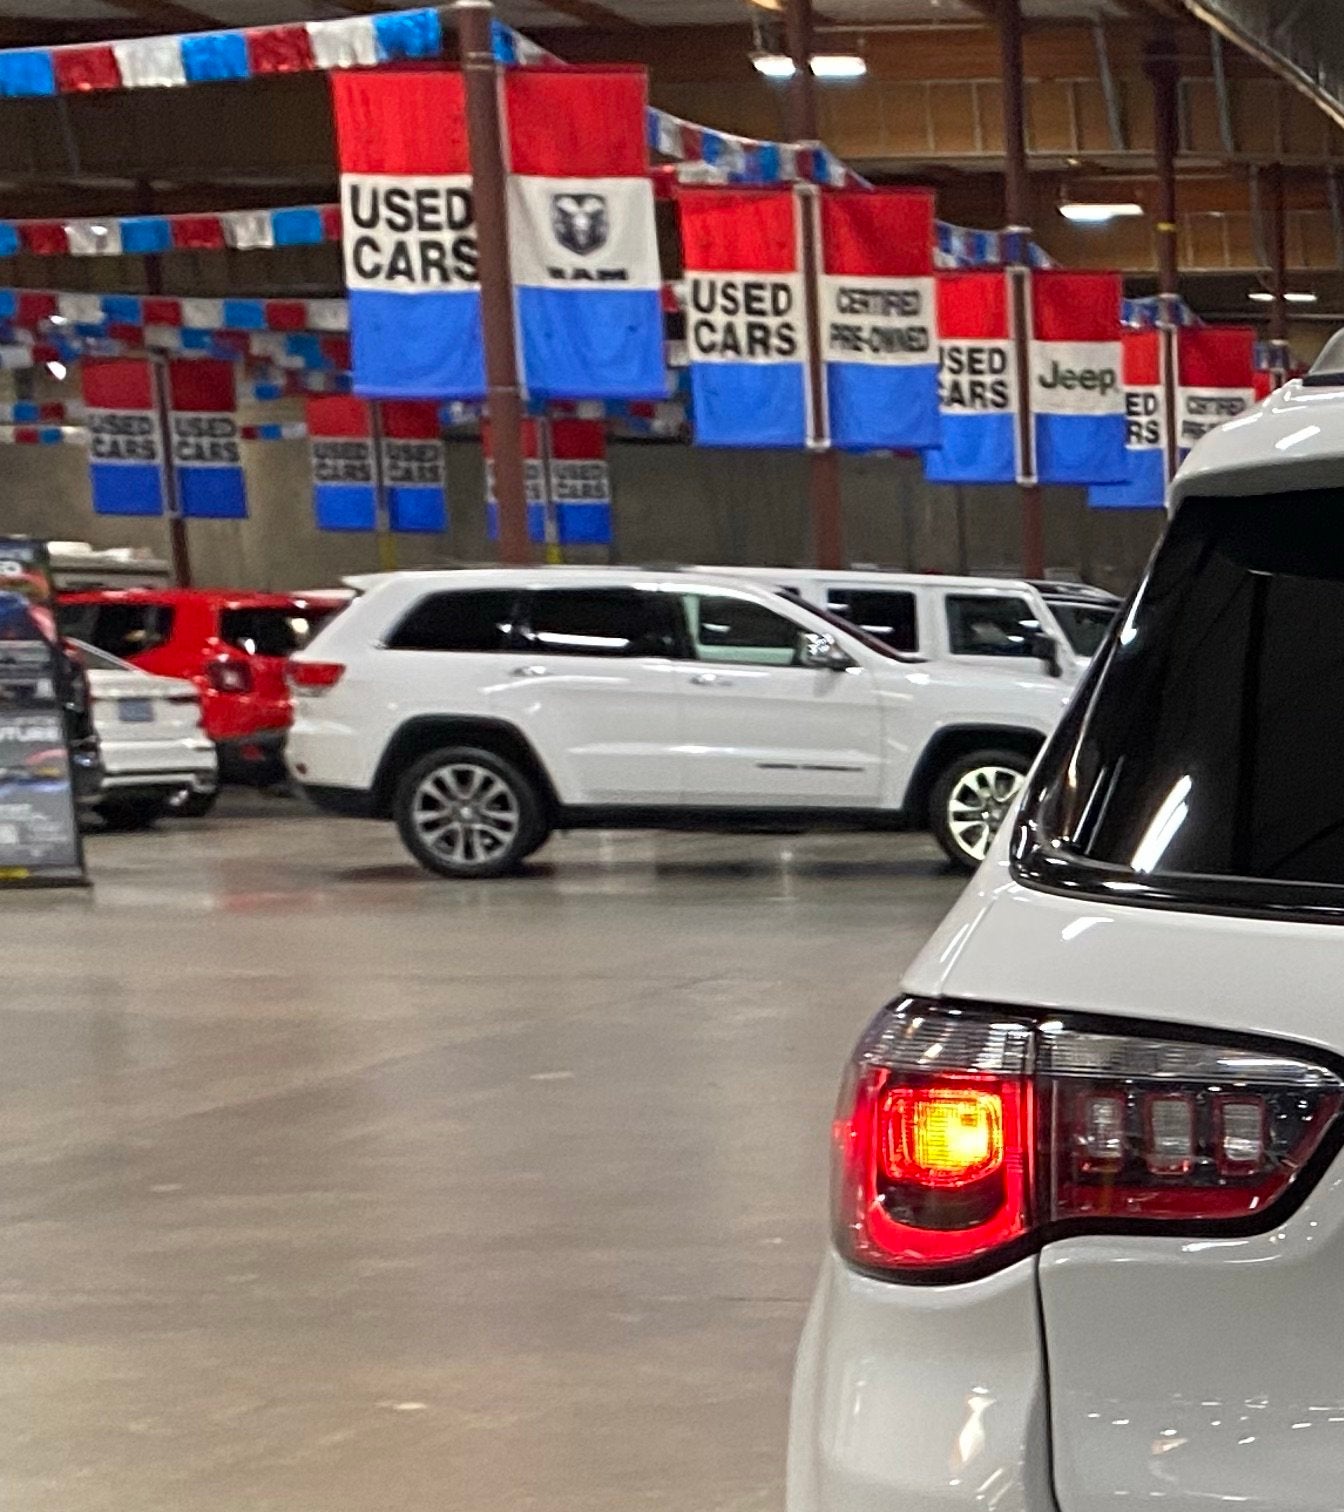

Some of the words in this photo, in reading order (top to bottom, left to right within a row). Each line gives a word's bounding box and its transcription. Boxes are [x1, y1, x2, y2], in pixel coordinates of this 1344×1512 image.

[349, 184, 475, 232] USED
[352, 236, 479, 282] CARS
[692, 279, 793, 317] USED
[694, 318, 797, 356] CARS
[1038, 361, 1118, 395] Jeep
